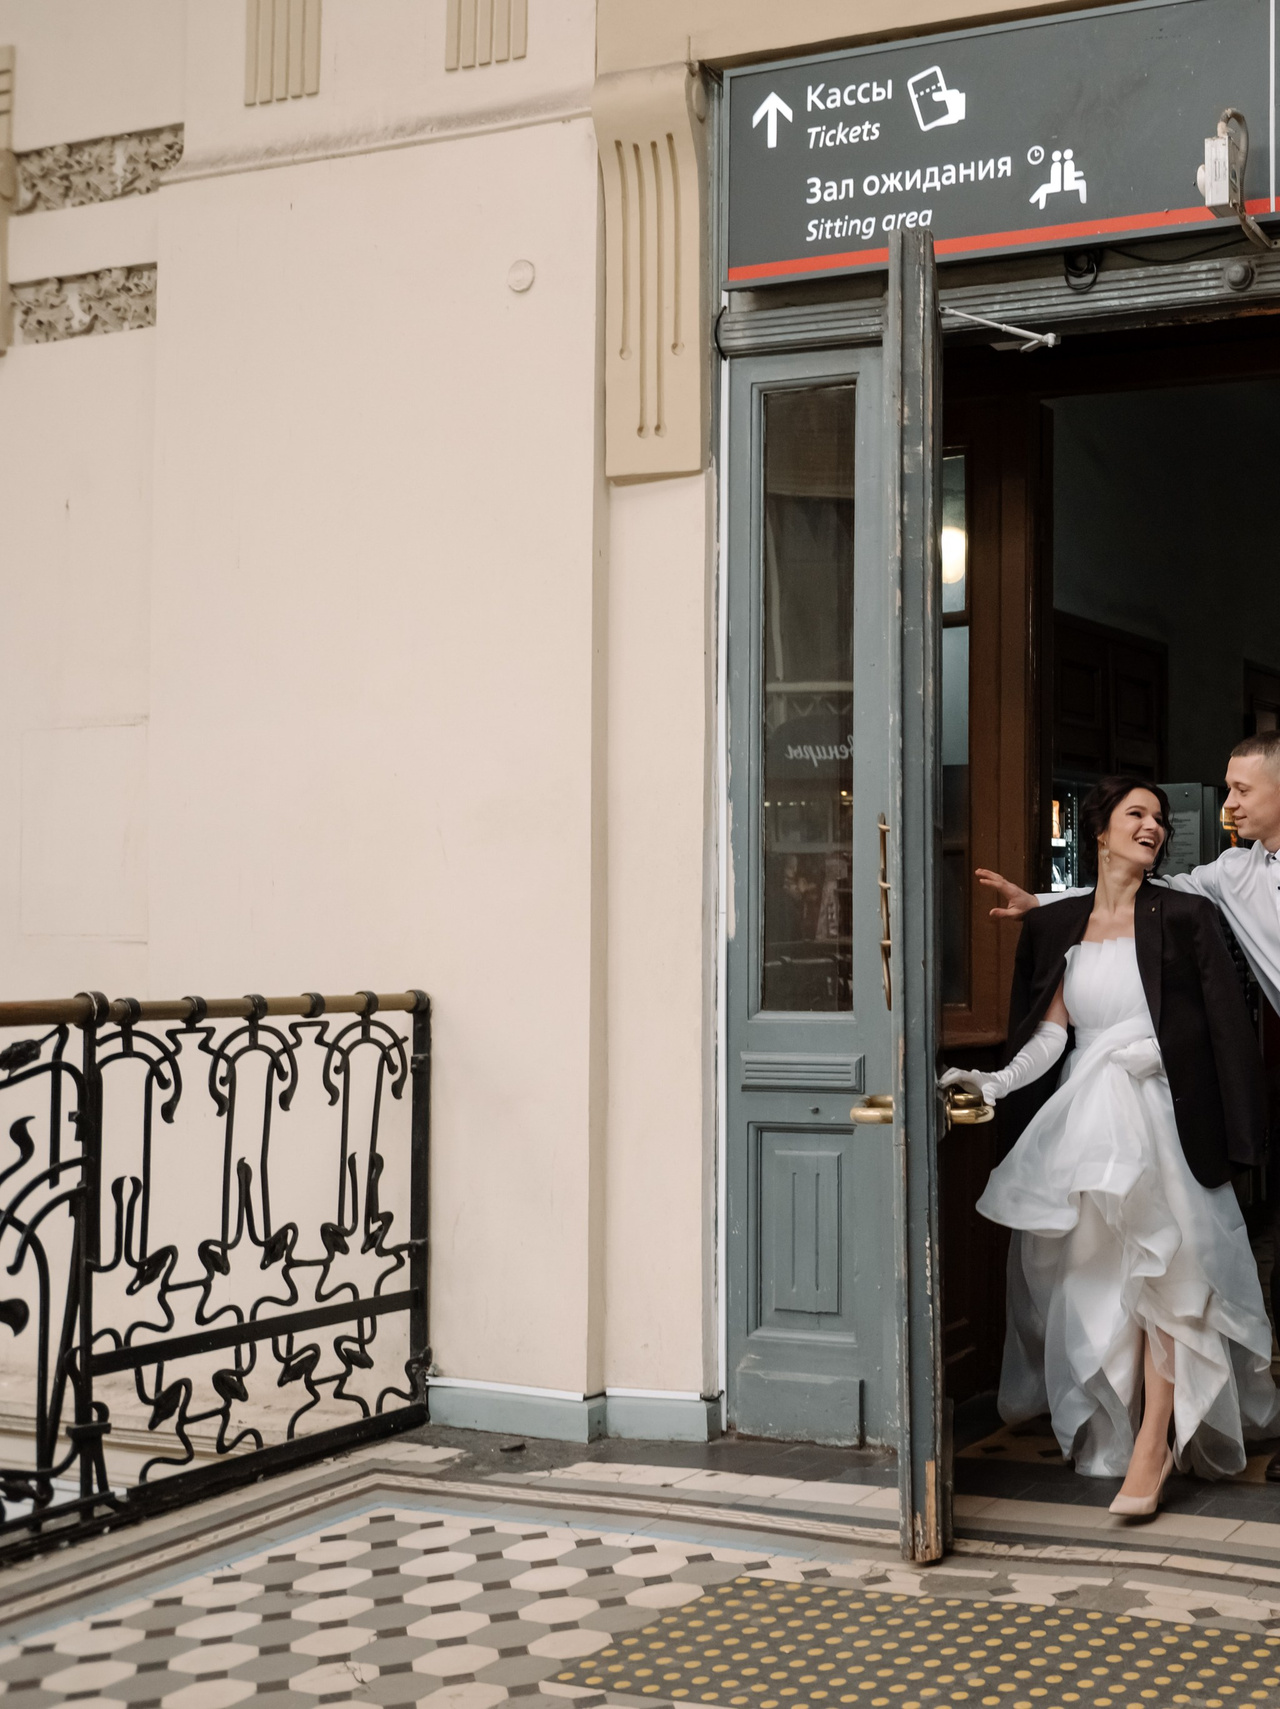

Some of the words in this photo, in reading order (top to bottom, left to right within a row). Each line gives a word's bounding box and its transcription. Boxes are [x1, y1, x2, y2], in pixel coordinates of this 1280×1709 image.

[806, 78, 893, 112] Кассы
[807, 120, 881, 149] Tickets
[806, 176, 855, 205] Зал
[862, 155, 1012, 196] ожидания
[806, 214, 876, 242] Sitting
[881, 209, 933, 231] area
